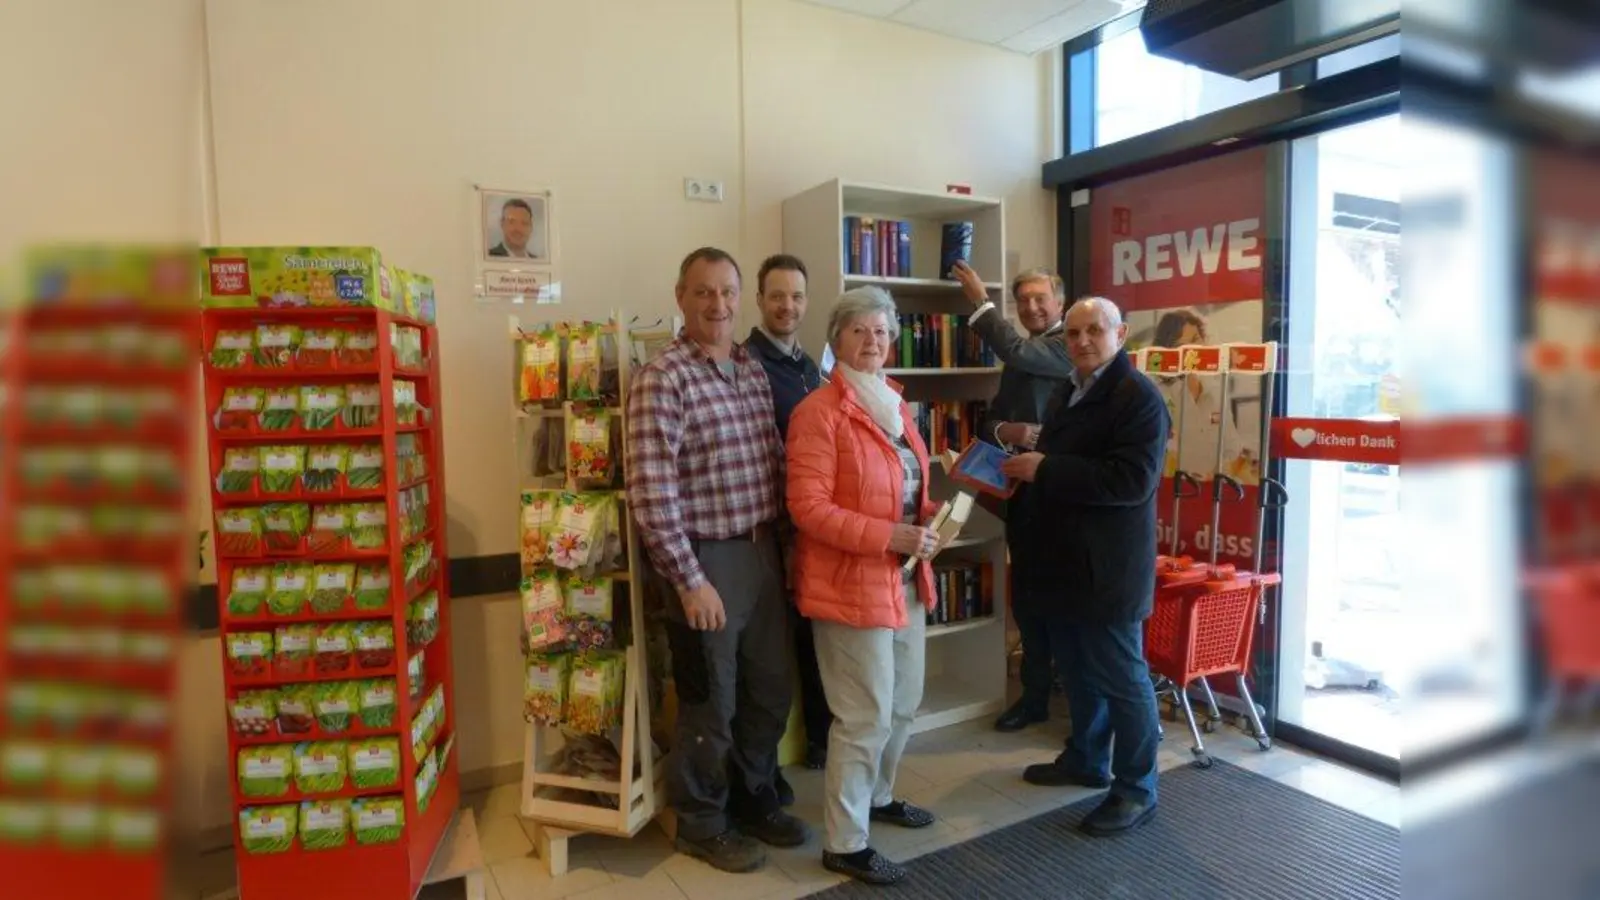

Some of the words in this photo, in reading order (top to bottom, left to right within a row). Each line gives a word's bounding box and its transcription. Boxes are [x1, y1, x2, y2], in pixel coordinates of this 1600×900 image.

[1112, 217, 1262, 286] REWE
[1315, 432, 1356, 447] lichen
[1360, 434, 1396, 449] Dank
[1194, 524, 1253, 558] dass
